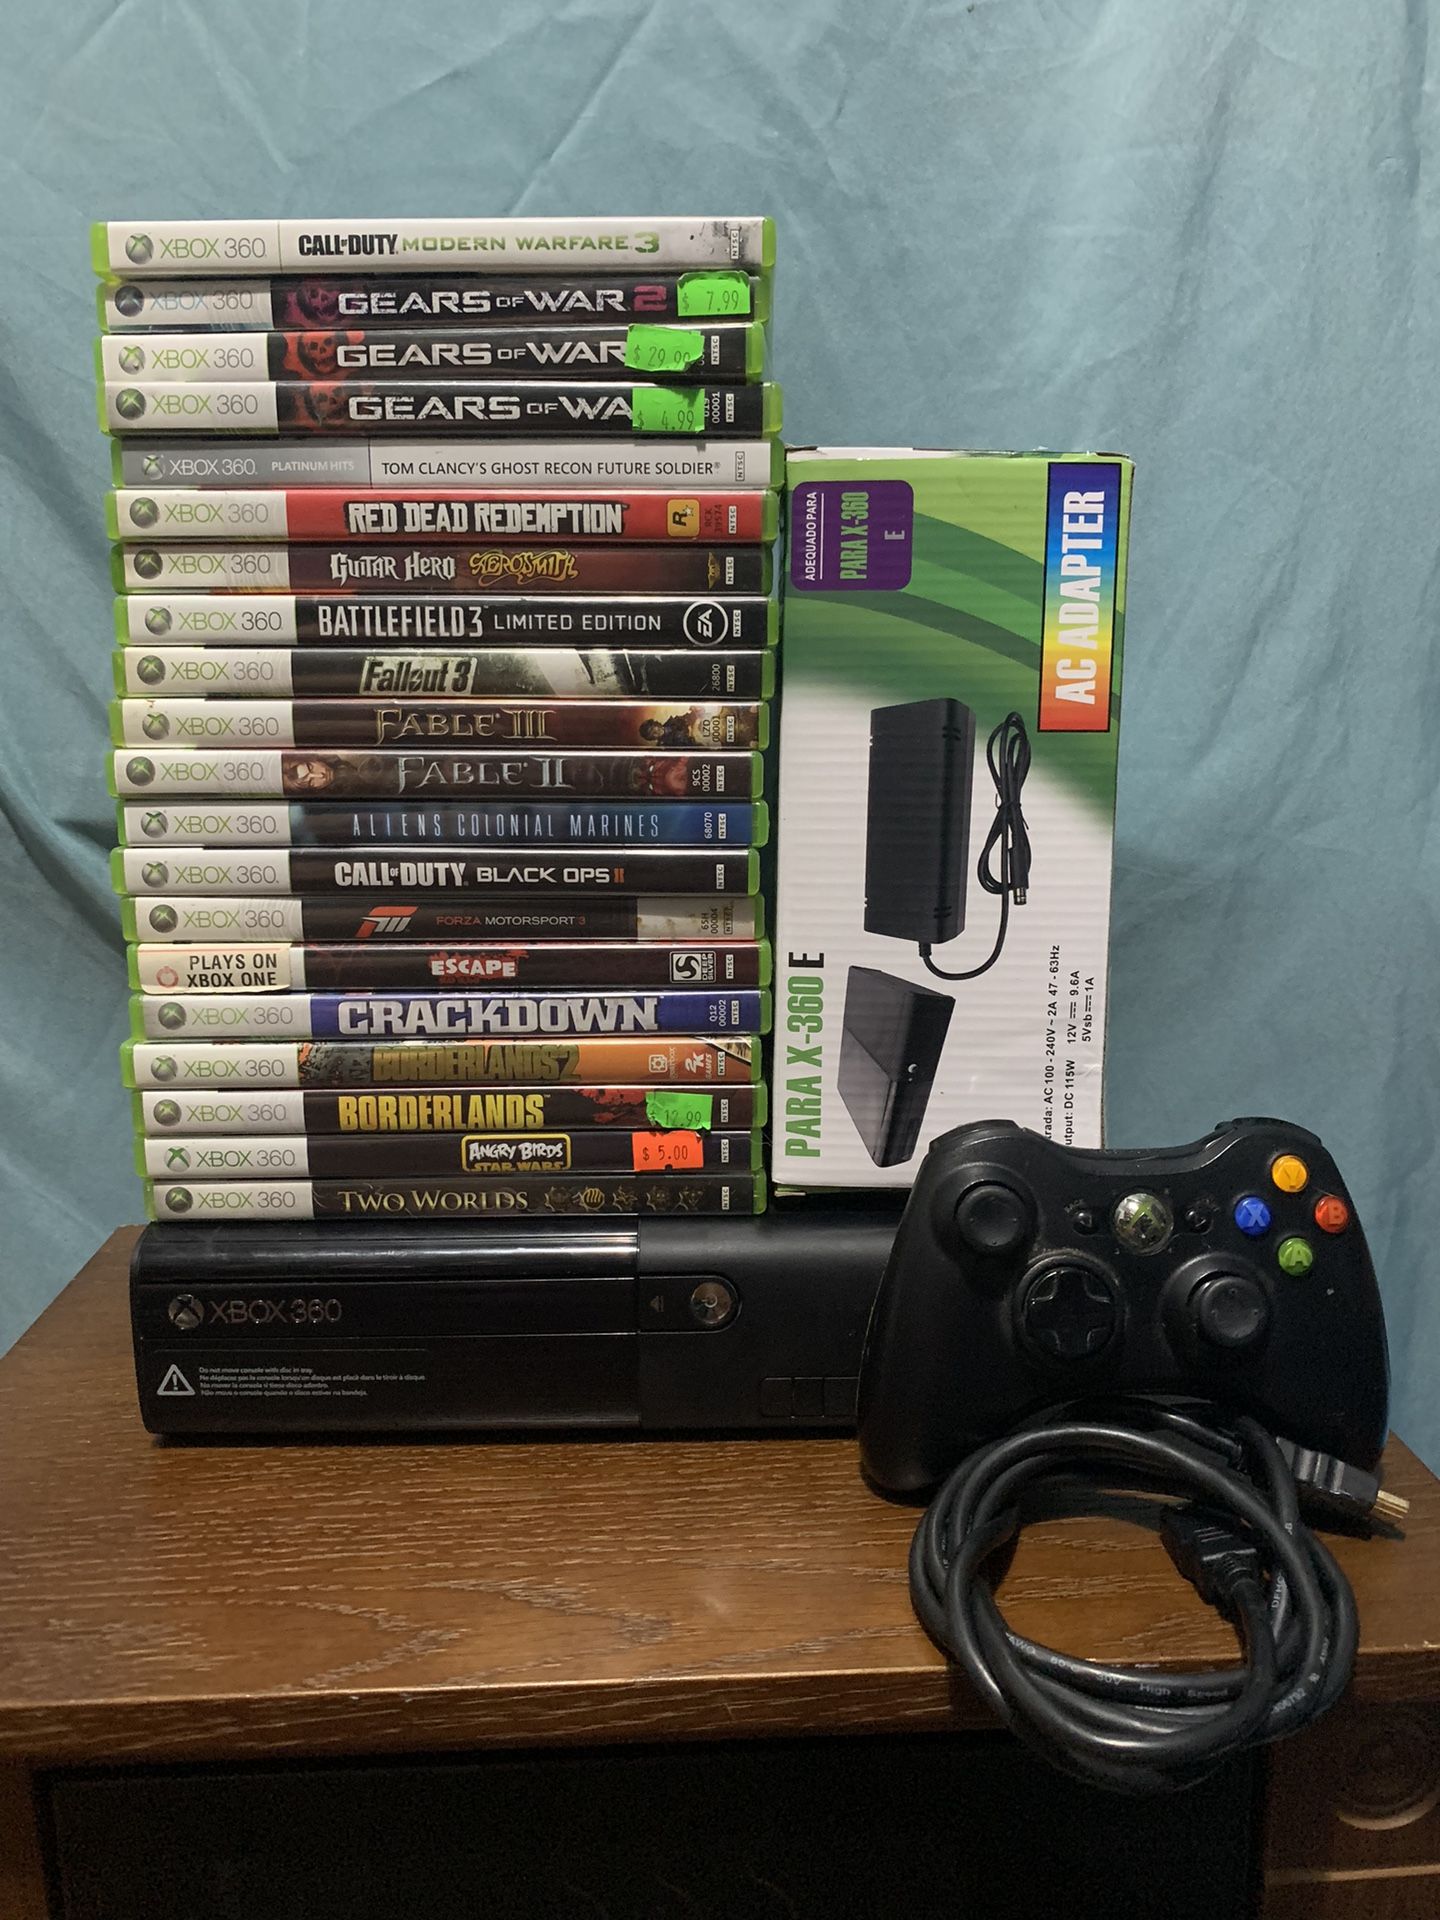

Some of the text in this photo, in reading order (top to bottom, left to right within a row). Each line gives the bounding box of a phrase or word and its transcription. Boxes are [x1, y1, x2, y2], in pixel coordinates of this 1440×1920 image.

[160, 238, 265, 258] XBOX 360
[298, 232, 659, 256] CALL DUTY MODERN WARFARE 3
[731, 231, 739, 258] NTSC
[338, 285, 667, 315] GEARS OF WAR 2
[682, 290, 739, 313] $ 7.99
[337, 341, 626, 367] GEARS OF WAR
[152, 394, 258, 415] XBOX 360
[349, 396, 633, 421] GEARS OF WA
[712, 391, 720, 424] 00001
[661, 411, 694, 430] 4.99
[170, 459, 256, 476] XBOX 360
[271, 460, 354, 473] PLATINUM HITS
[382, 462, 414, 475] TOM
[419, 462, 487, 475] CLANCY'S
[491, 462, 539, 475] GHOST
[544, 462, 592, 475] RECON
[597, 462, 650, 474] FUTURE
[349, 502, 622, 533] RED DEAD REDEMPTION
[729, 507, 737, 533] NTSC
[805, 492, 818, 581] ADEQUADO PARA
[884, 530, 905, 540] E
[169, 555, 270, 574] XBOX 360
[840, 539, 868, 579] PARA
[1055, 490, 1105, 705] AC ADAPTER
[179, 612, 281, 630] XBOX 360
[318, 606, 661, 637] BATTLEFIELD 3 LIMITED EDITION
[698, 609, 713, 638] EA
[364, 659, 472, 694] Fallout 3
[712, 664, 721, 692] 26800
[176, 717, 279, 735] XBOX 360
[374, 709, 558, 745] FABLE III
[161, 762, 263, 781] XBOX 360
[398, 757, 575, 793] FABLE II
[692, 769, 700, 786] 9CS
[702, 764, 711, 792] 00002
[174, 816, 276, 834] XBOX 360
[353, 814, 659, 837] ALIENS COLONIAL MARINES
[704, 811, 713, 839] 68070
[175, 866, 277, 884] XBOX 360
[334, 862, 394, 886] CALL
[401, 862, 466, 886] DUTY
[477, 867, 556, 883] BLACK
[563, 868, 610, 883] OPS
[614, 868, 625, 883] II
[436, 916, 586, 926] FORZA MOTORSPORT 3
[190, 954, 277, 970] PLAYS ON
[431, 959, 516, 977] ESCAPE
[788, 952, 824, 968] E
[187, 972, 277, 987] XBOX ONE
[338, 998, 657, 1035] CRACKDOWN
[709, 1004, 717, 1022] Q12
[1082, 977, 1094, 1042] 5Vsb 1A
[1043, 945, 1060, 1105] AC 100 240V 2A 47 63Hz
[184, 1060, 285, 1078] XBOX 360
[373, 1044, 581, 1081] BORDERLANDS 2
[685, 1052, 704, 1073] 2K
[1064, 970, 1080, 1145] utput: DC 115W 12V 9.6A
[338, 1094, 544, 1131] BORDERLANDS
[785, 1075, 822, 1158] PARA
[197, 1150, 295, 1167] XBOX 360
[469, 1142, 563, 1161] ANGRY BIRDS
[643, 1145, 688, 1160] $ 5.00
[474, 1162, 564, 1171] STAR WARS
[198, 1191, 295, 1208] XBOX 360
[337, 1189, 528, 1213] TWO WORLDS
[1246, 1203, 1266, 1227] X
[1328, 1203, 1346, 1226] B
[1290, 1246, 1310, 1266] A
[209, 1299, 342, 1324] XBOX 360
